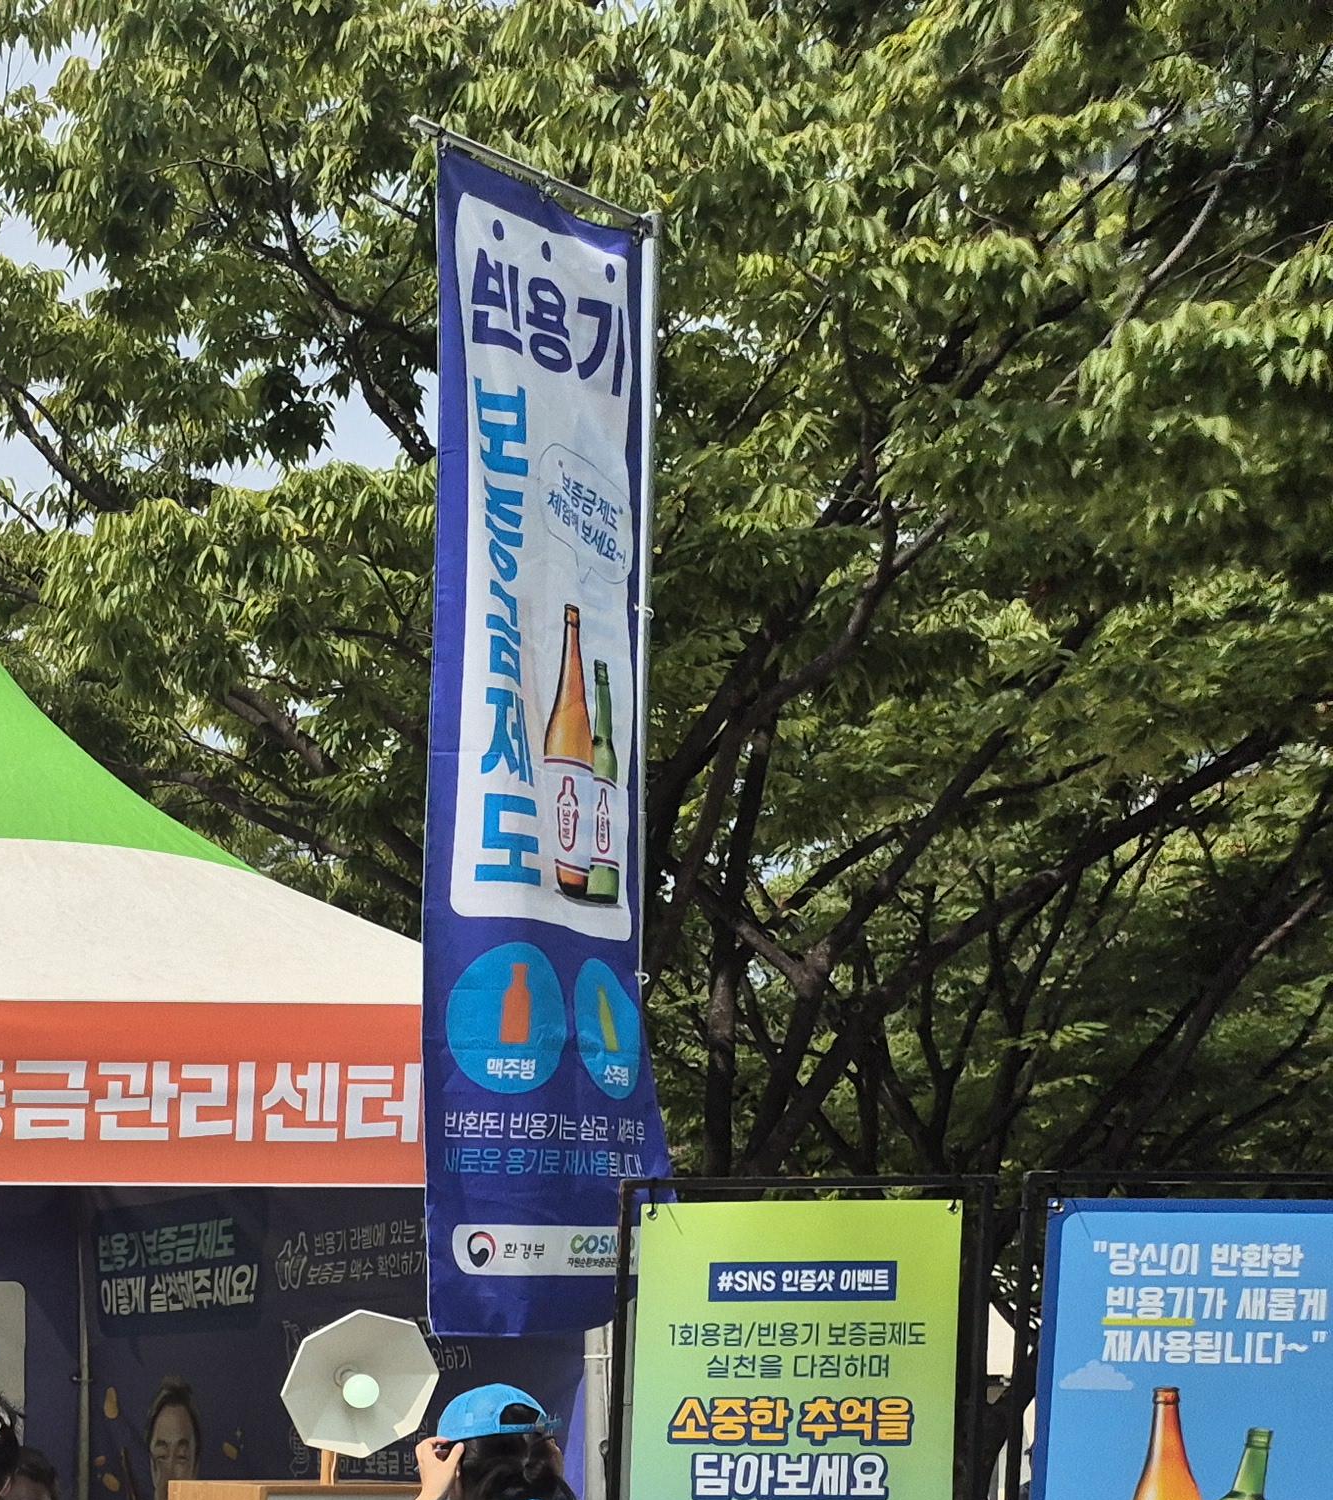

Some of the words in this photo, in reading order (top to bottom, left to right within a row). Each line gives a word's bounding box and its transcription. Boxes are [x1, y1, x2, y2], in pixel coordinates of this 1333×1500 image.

[471, 248, 623, 397] 빈용기
[474, 376, 541, 886] 보증금제도
[486, 1058, 536, 1081] 맥주병
[444, 1111, 505, 1139] 반환된
[509, 1112, 577, 1141] 빈용기는
[444, 1148, 502, 1174] 새로운
[505, 1148, 560, 1175] 용기로
[313, 1230, 347, 1256] 빈용기
[390, 1219, 416, 1245] 있는
[503, 1242, 545, 1260] 환경부
[306, 1261, 347, 1285] 보증금
[350, 1257, 374, 1281] 액수
[377, 1251, 426, 1278] 확인하기
[1210, 1243, 1304, 1278] 반환한
[101, 1274, 145, 1316] 이렇게
[717, 1270, 775, 1292] #SNS
[781, 1270, 835, 1293] 인증샷
[840, 1269, 889, 1291] 이벤트
[1105, 1287, 1228, 1320] 빈용기가
[1236, 1287, 1328, 1321] 새롭게
[668, 1321, 820, 1348] 1회용컵/빈용기
[827, 1321, 926, 1347] 보증금제도
[434, 1345, 472, 1370] 인하기
[706, 1354, 783, 1380] 실천을
[793, 1353, 890, 1380] 다짐하며
[670, 1397, 791, 1443] 소중한
[799, 1397, 912, 1443] 추억을
[694, 1453, 885, 1498] 담아보세요
